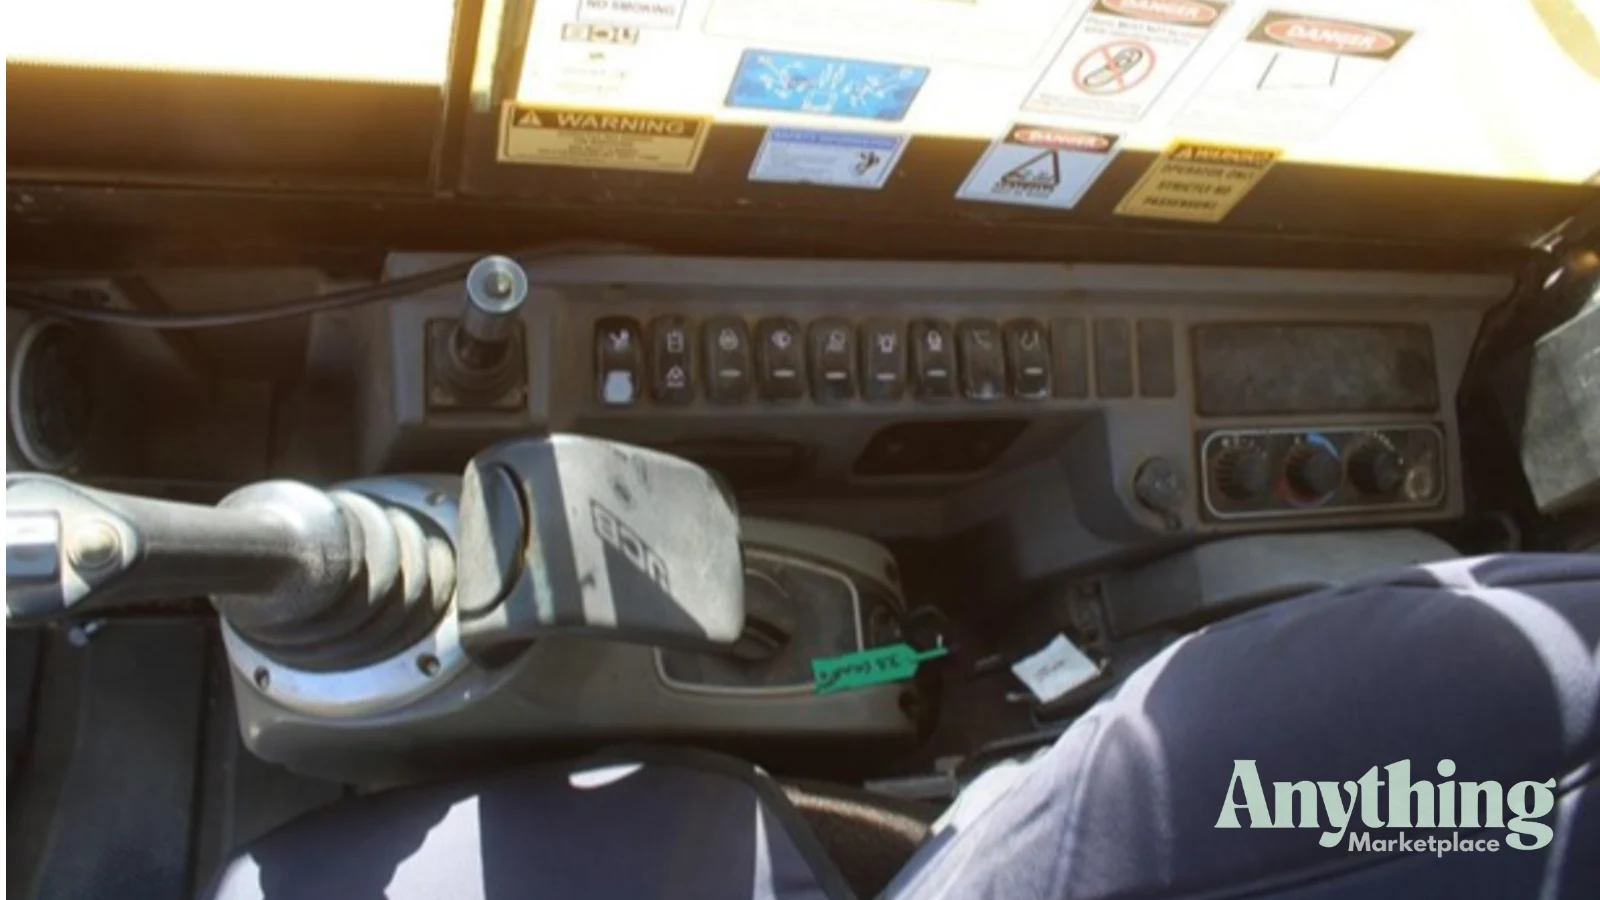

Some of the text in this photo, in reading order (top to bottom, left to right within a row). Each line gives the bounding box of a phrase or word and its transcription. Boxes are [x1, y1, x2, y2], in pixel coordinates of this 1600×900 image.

[586, 0, 675, 16] NO SMOKING
[1119, 0, 1198, 18] DANGER
[1287, 24, 1377, 50] DANGER
[556, 111, 686, 135] WARNING
[1028, 129, 1096, 147] DANGER
[1160, 163, 1256, 182] OPERATOR ONLY
[1156, 180, 1232, 196] STRICTLY NO
[590, 499, 670, 593] JCB
